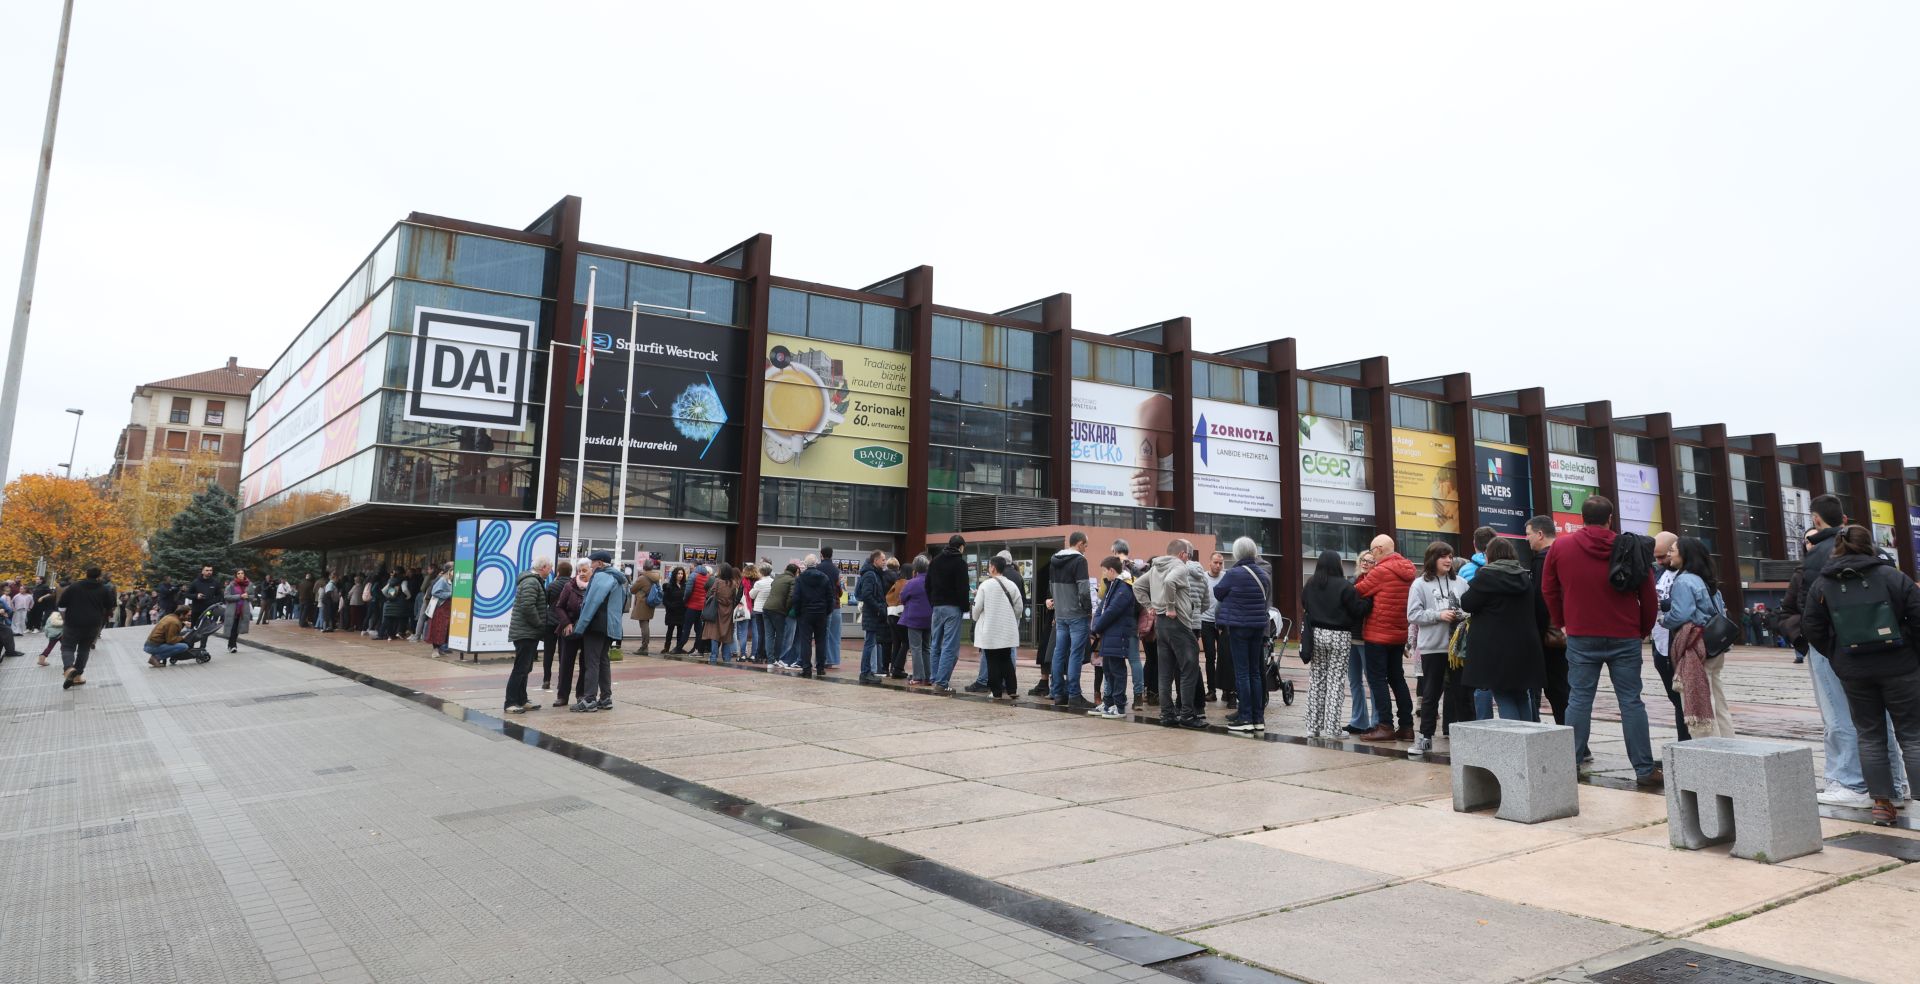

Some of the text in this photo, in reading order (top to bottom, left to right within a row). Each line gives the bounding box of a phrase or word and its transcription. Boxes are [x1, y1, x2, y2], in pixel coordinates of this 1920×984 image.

[665, 344, 718, 362] Westrock
[431, 344, 509, 395] DA!
[863, 357, 907, 372] Tradizioek
[881, 370, 907, 382] bizirik
[851, 376, 906, 392] irauten dute
[854, 401, 905, 417] Zorionak!
[853, 415, 870, 427] 60.
[1211, 424, 1274, 442] ZORNOTZA
[617, 437, 678, 452] klturarekin
[1217, 448, 1269, 461] LANBIDE HEZIKETA
[1560, 460, 1595, 475] Selekzioa
[1481, 484, 1512, 498] NEVERS
